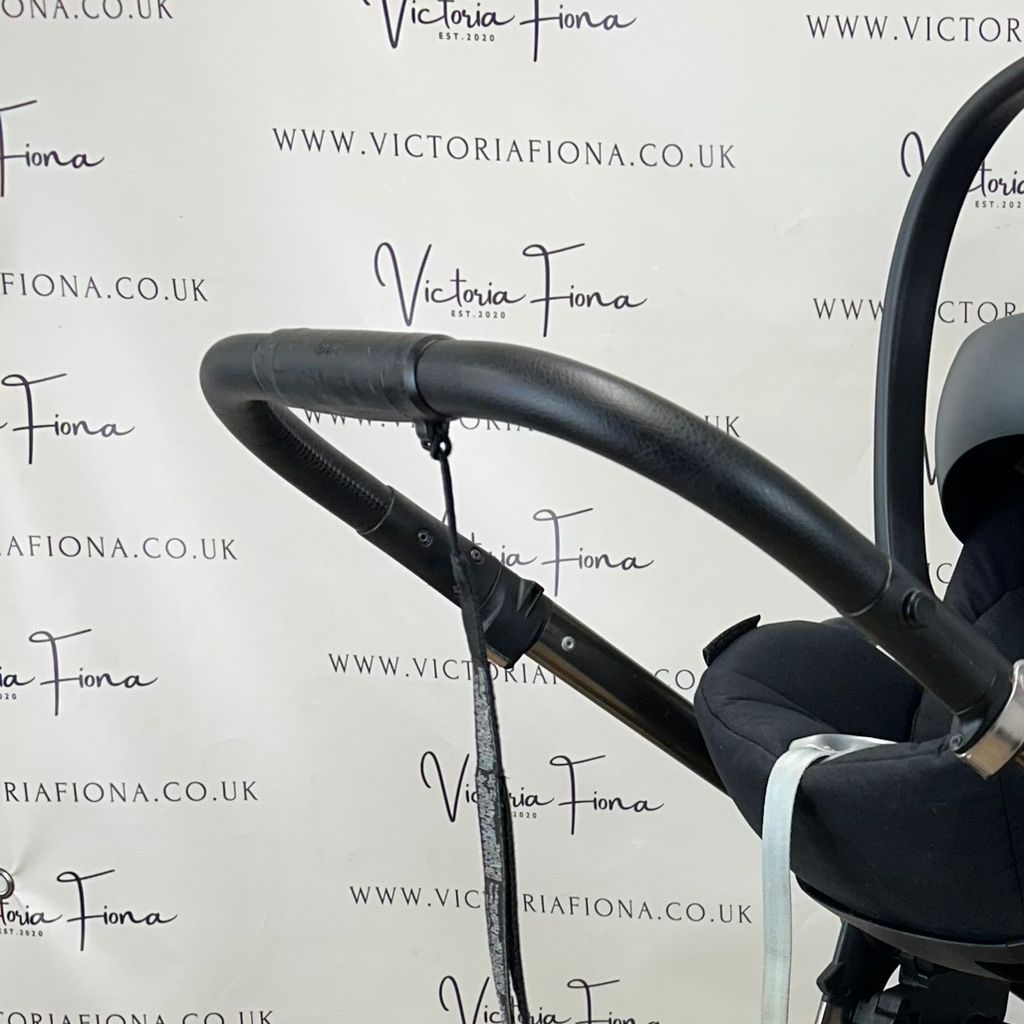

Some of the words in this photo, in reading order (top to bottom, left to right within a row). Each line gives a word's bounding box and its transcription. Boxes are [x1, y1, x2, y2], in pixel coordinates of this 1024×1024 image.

[272, 128, 736, 169] WWW.VICTORIAFIONA.CO.UK
[374, 242, 526, 327] Victoria
[522, 243, 648, 337] Fiona
[1, 373, 135, 465] Fiona
[533, 507, 655, 597] Fiona
[29, 629, 158, 716] Fiona
[550, 755, 664, 835] Fiona
[56, 869, 178, 952] Fiona
